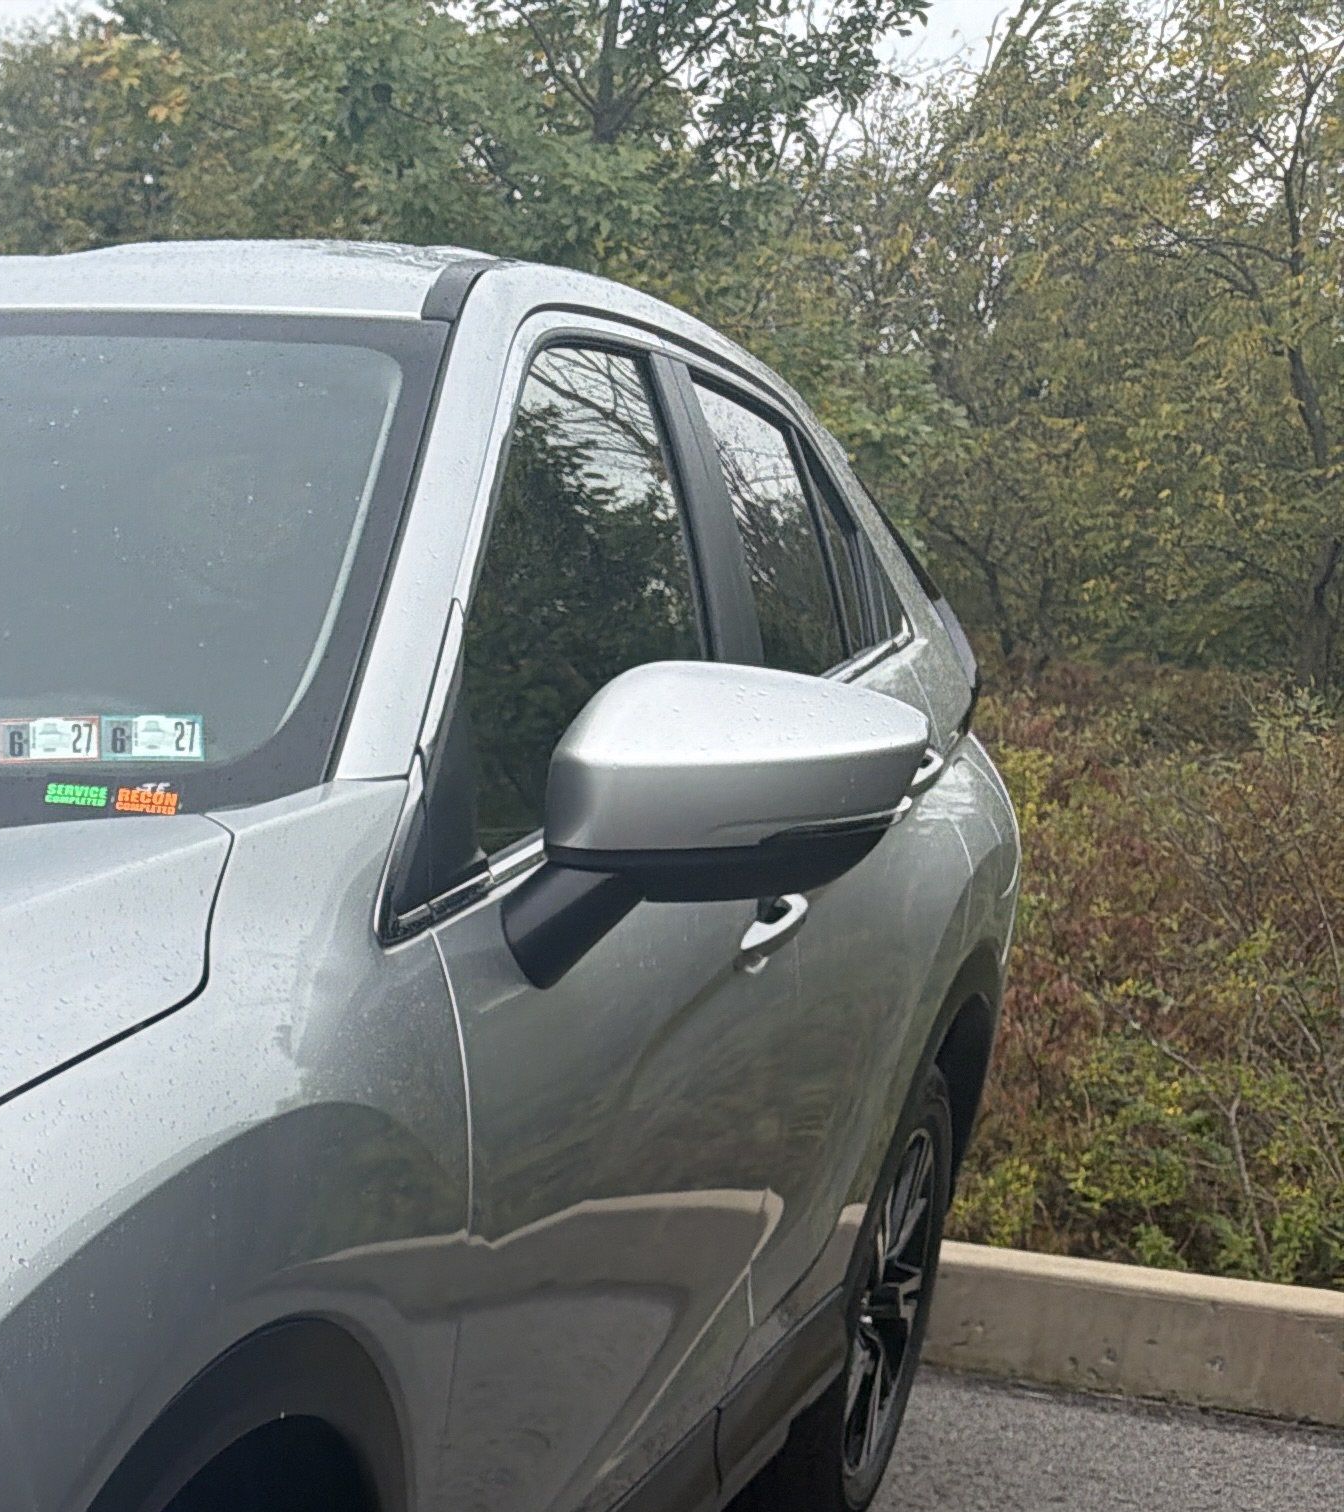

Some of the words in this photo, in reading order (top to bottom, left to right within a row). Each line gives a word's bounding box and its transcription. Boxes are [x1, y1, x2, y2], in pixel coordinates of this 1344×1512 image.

[8, 730, 24, 757] 6
[71, 723, 93, 754] 27
[110, 726, 126, 754] 6
[174, 721, 196, 752] 27
[46, 782, 109, 799] SERVICE
[117, 788, 178, 807] RECON
[44, 793, 107, 807] COMPLETED
[115, 801, 176, 815] COMPLETED
